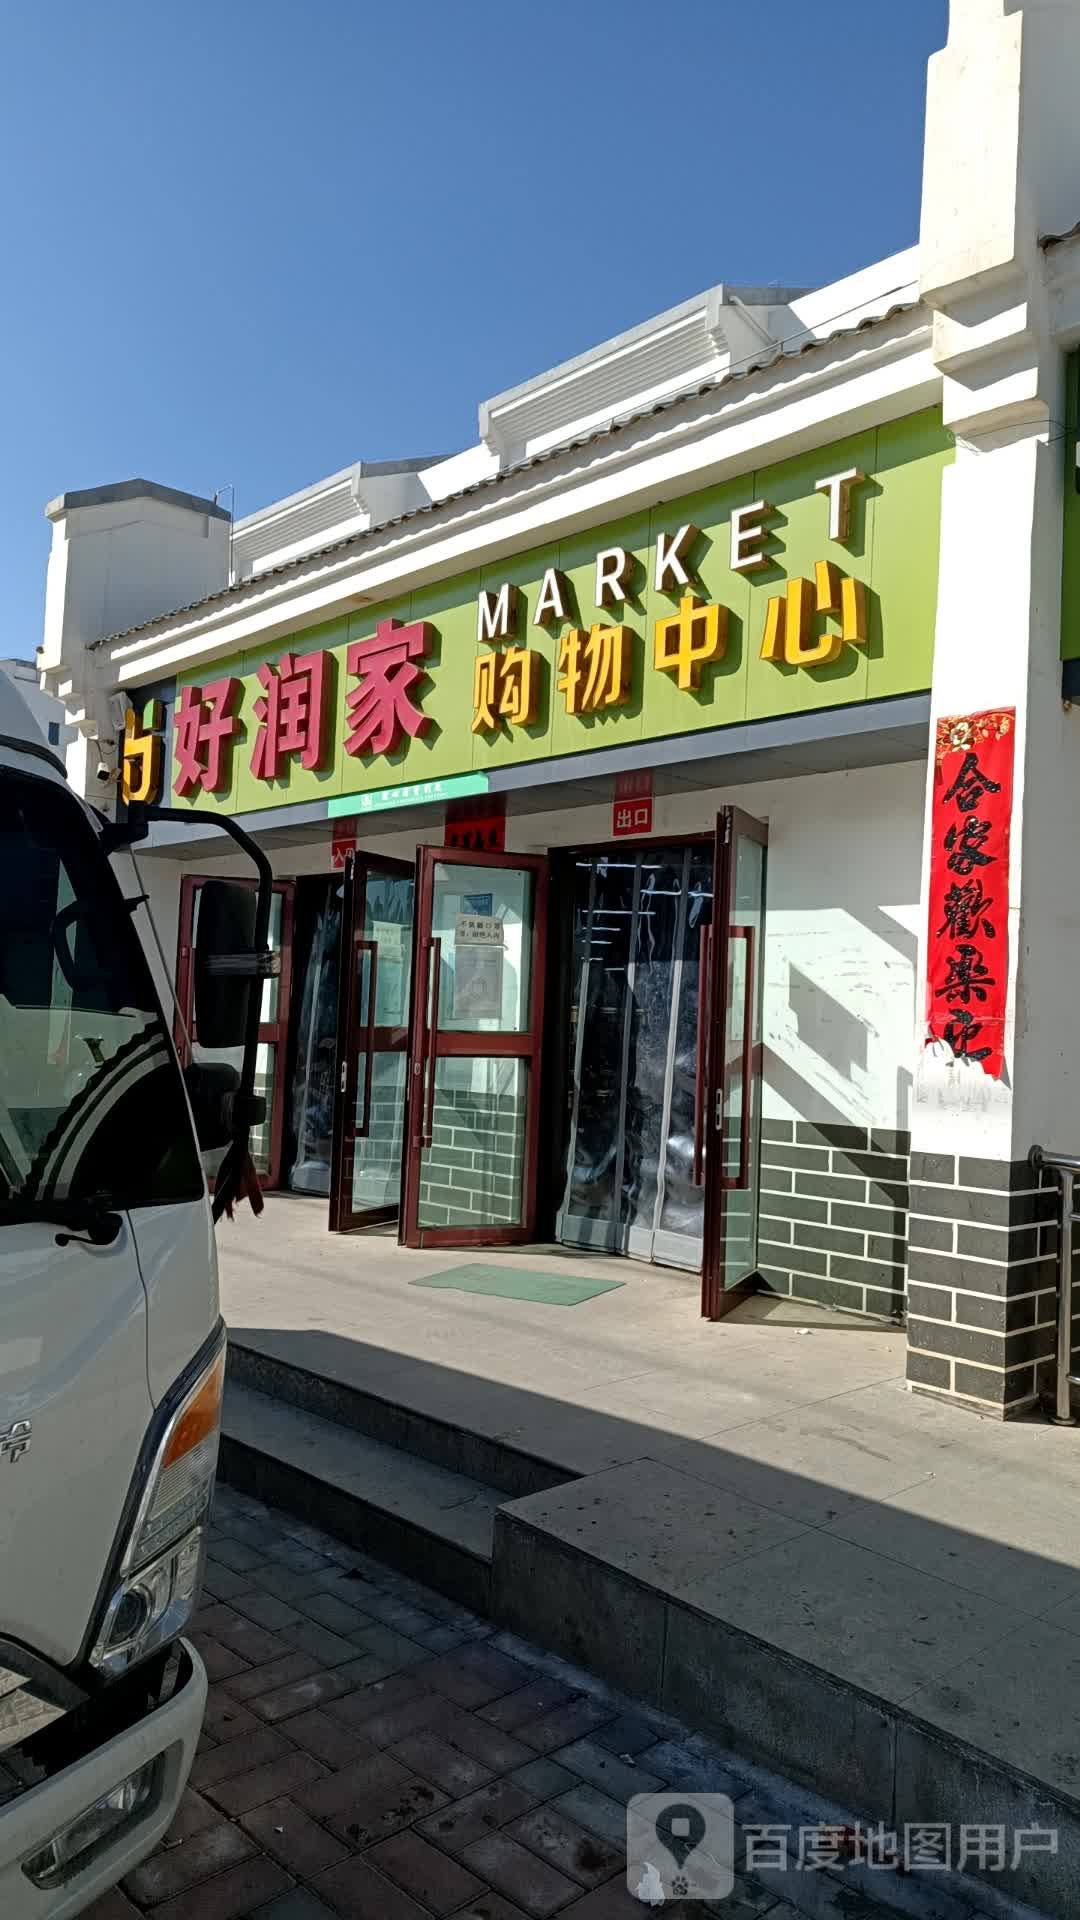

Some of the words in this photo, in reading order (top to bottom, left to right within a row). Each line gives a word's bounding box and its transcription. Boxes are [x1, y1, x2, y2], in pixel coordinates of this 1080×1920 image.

[477, 467, 864, 642] MARKET
[173, 618, 433, 797] 好润家
[471, 560, 867, 735] 购物中心
[616, 808, 649, 829] 出口
